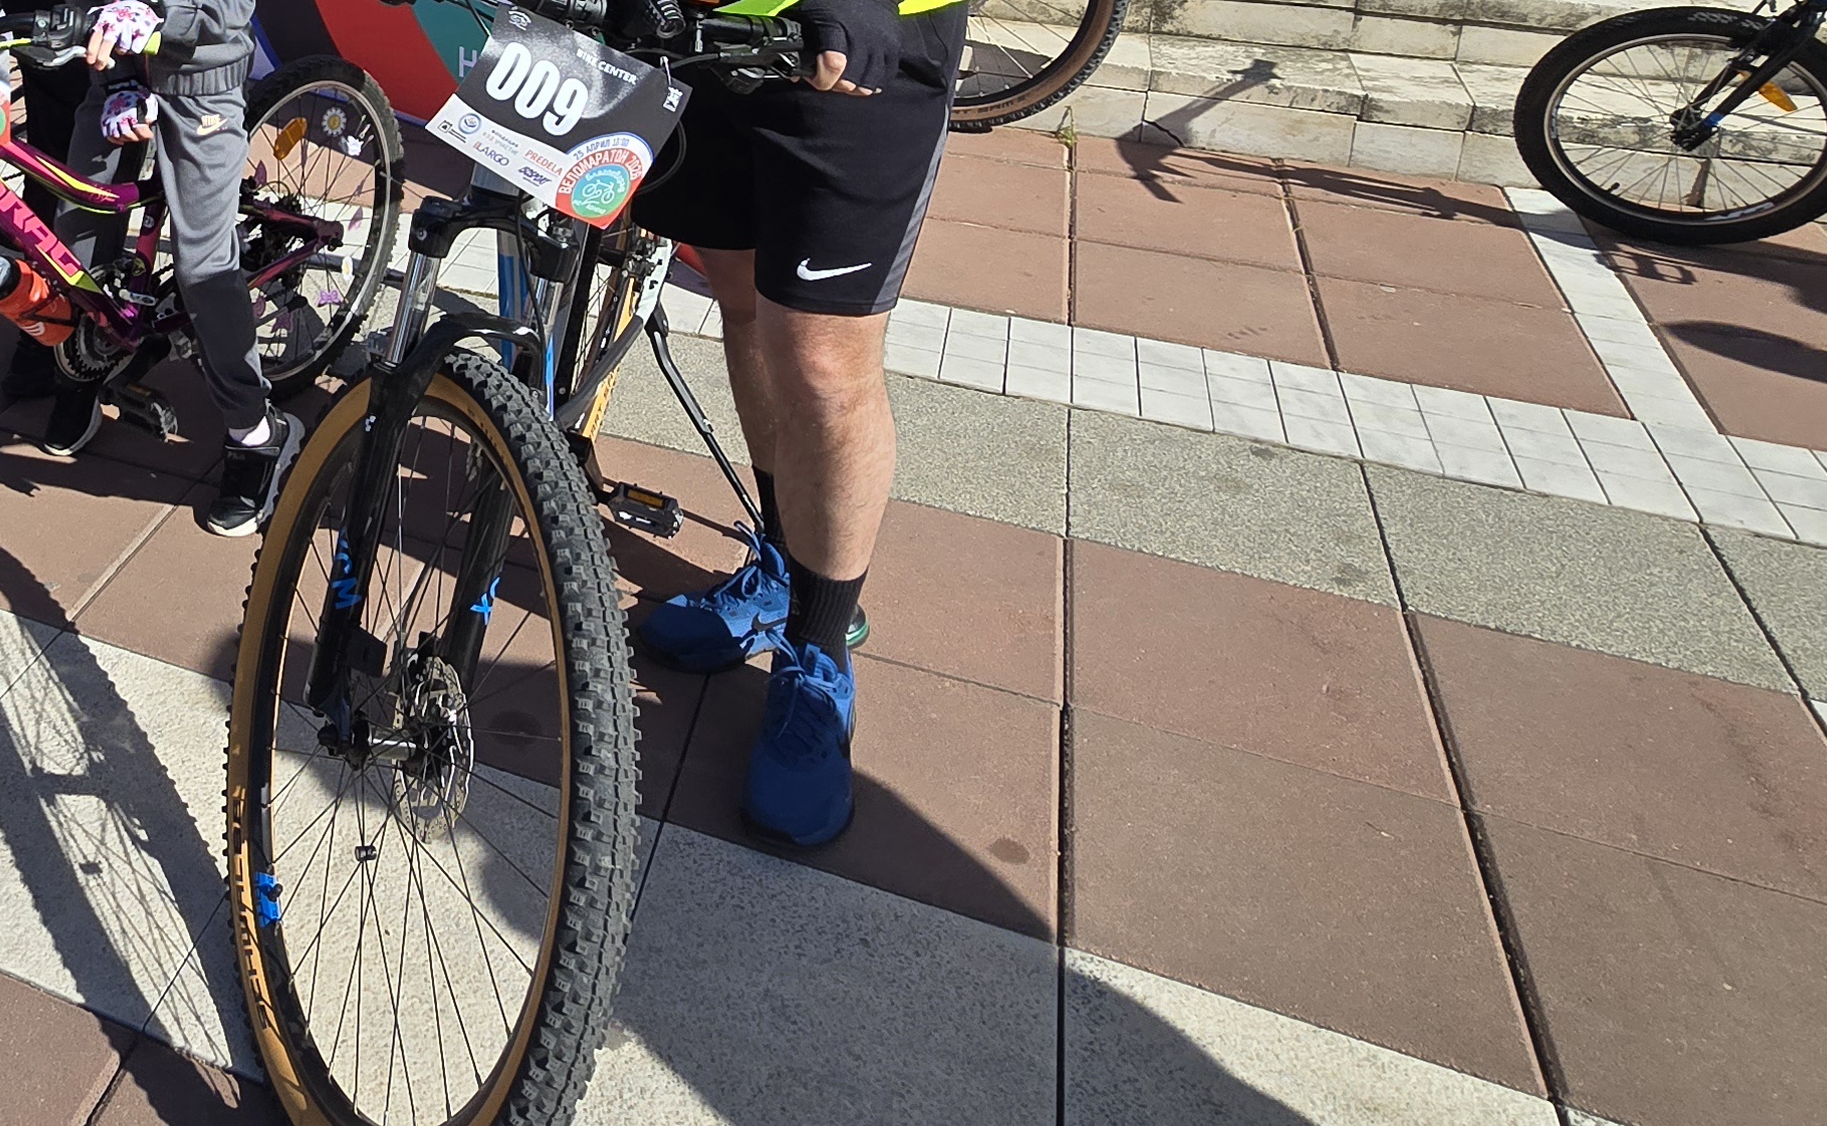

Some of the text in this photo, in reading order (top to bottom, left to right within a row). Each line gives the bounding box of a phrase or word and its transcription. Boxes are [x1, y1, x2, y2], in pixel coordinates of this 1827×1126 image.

[485, 41, 589, 136] 009
[598, 60, 638, 86] CENTER
[525, 149, 564, 176] PREDELA
[558, 149, 628, 195] ВЕЛОМАРАТОН
